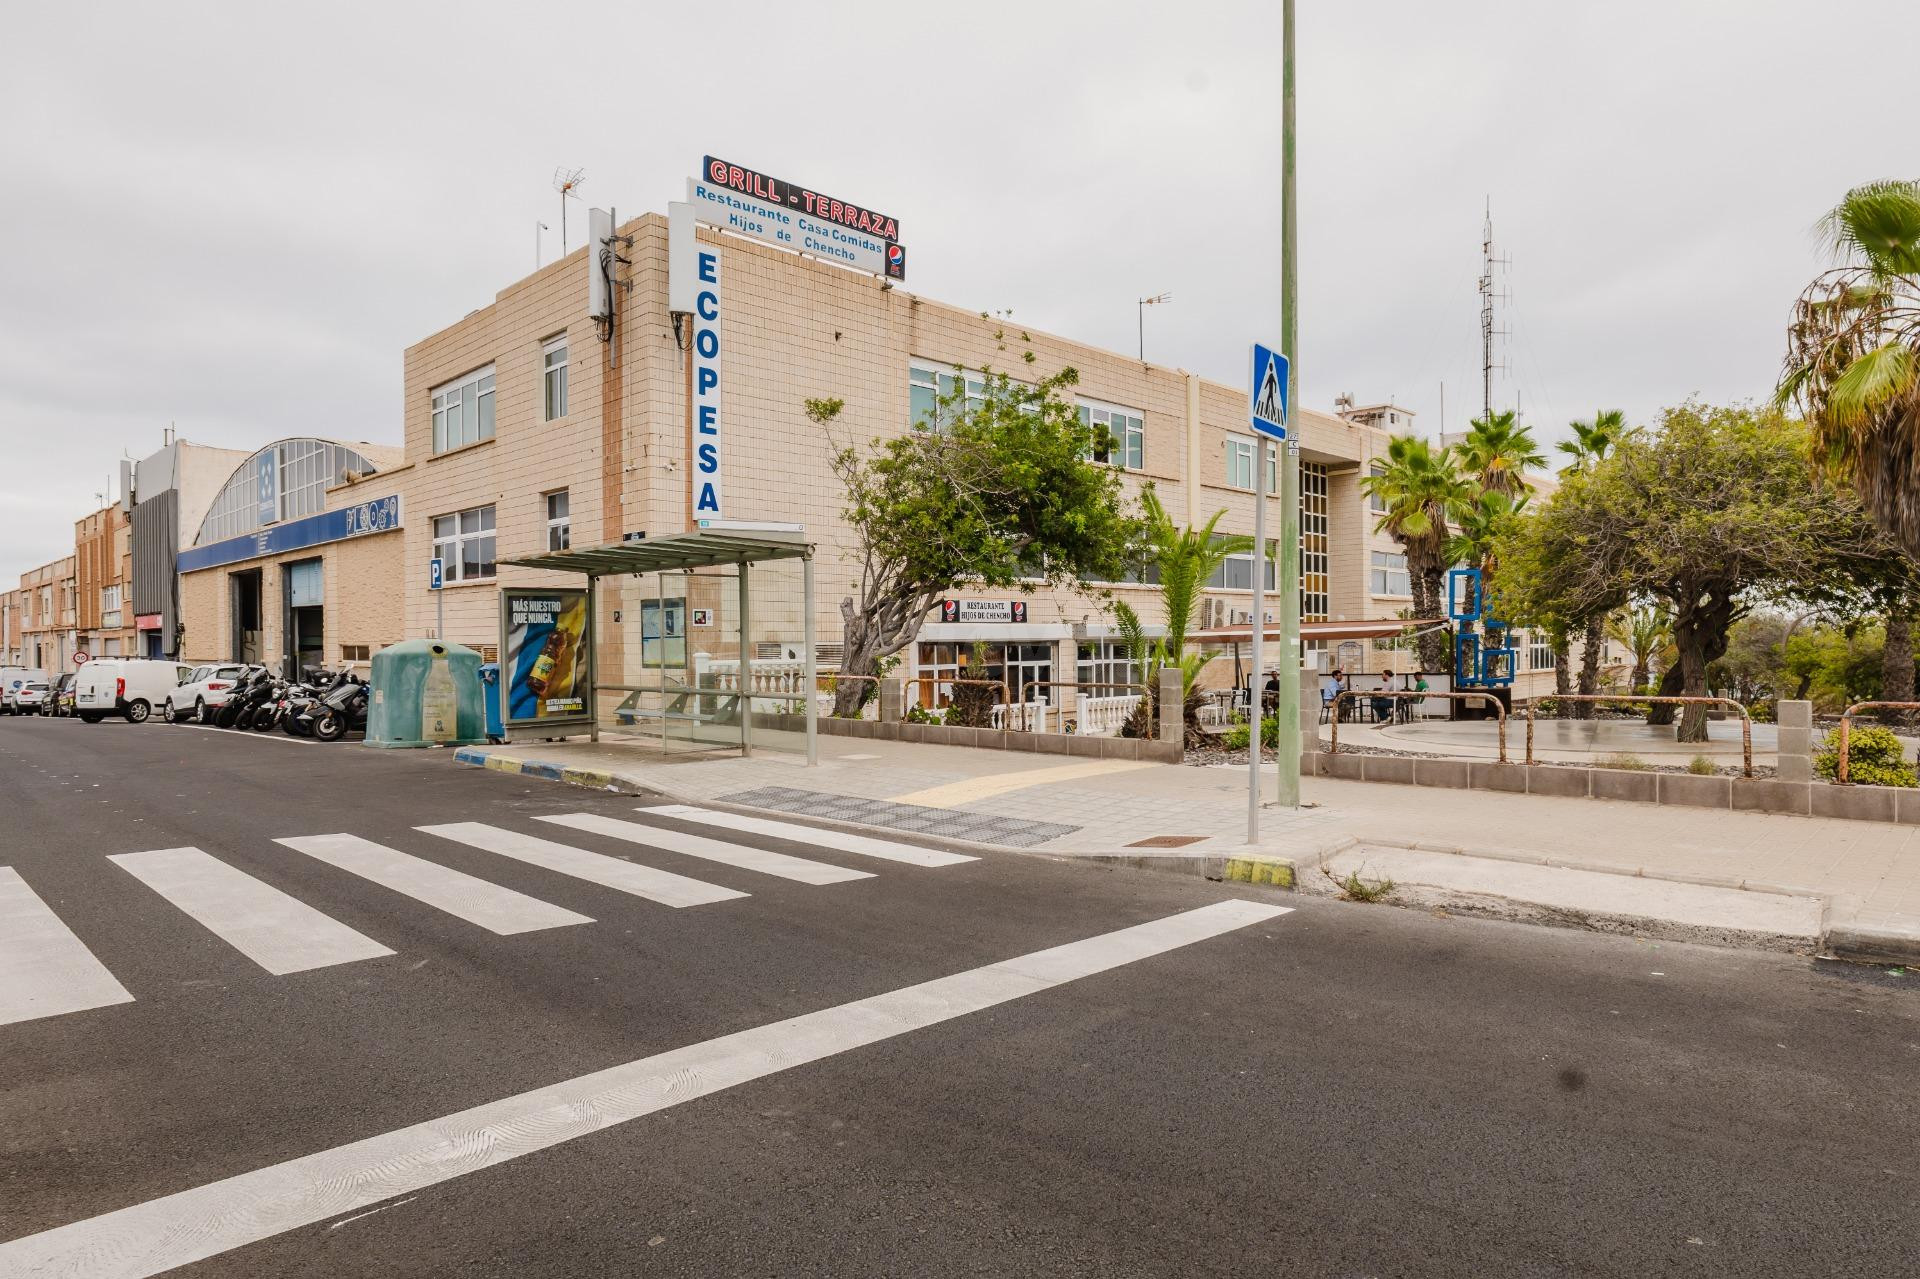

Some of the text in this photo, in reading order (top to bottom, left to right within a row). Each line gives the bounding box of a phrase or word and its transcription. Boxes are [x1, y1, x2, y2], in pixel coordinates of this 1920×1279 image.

[710, 160, 780, 202] GRILL
[803, 191, 897, 240] TERRAZA
[696, 186, 882, 253] Restaurante Casa Comidas
[729, 213, 855, 261] Hijos de Chencho
[696, 251, 719, 512] ECOPESA
[432, 563, 439, 584] P
[513, 599, 561, 612] MÁS NUESTRO
[513, 613, 554, 626] QUE NUNCA.
[961, 612, 976, 620] HIJOS
